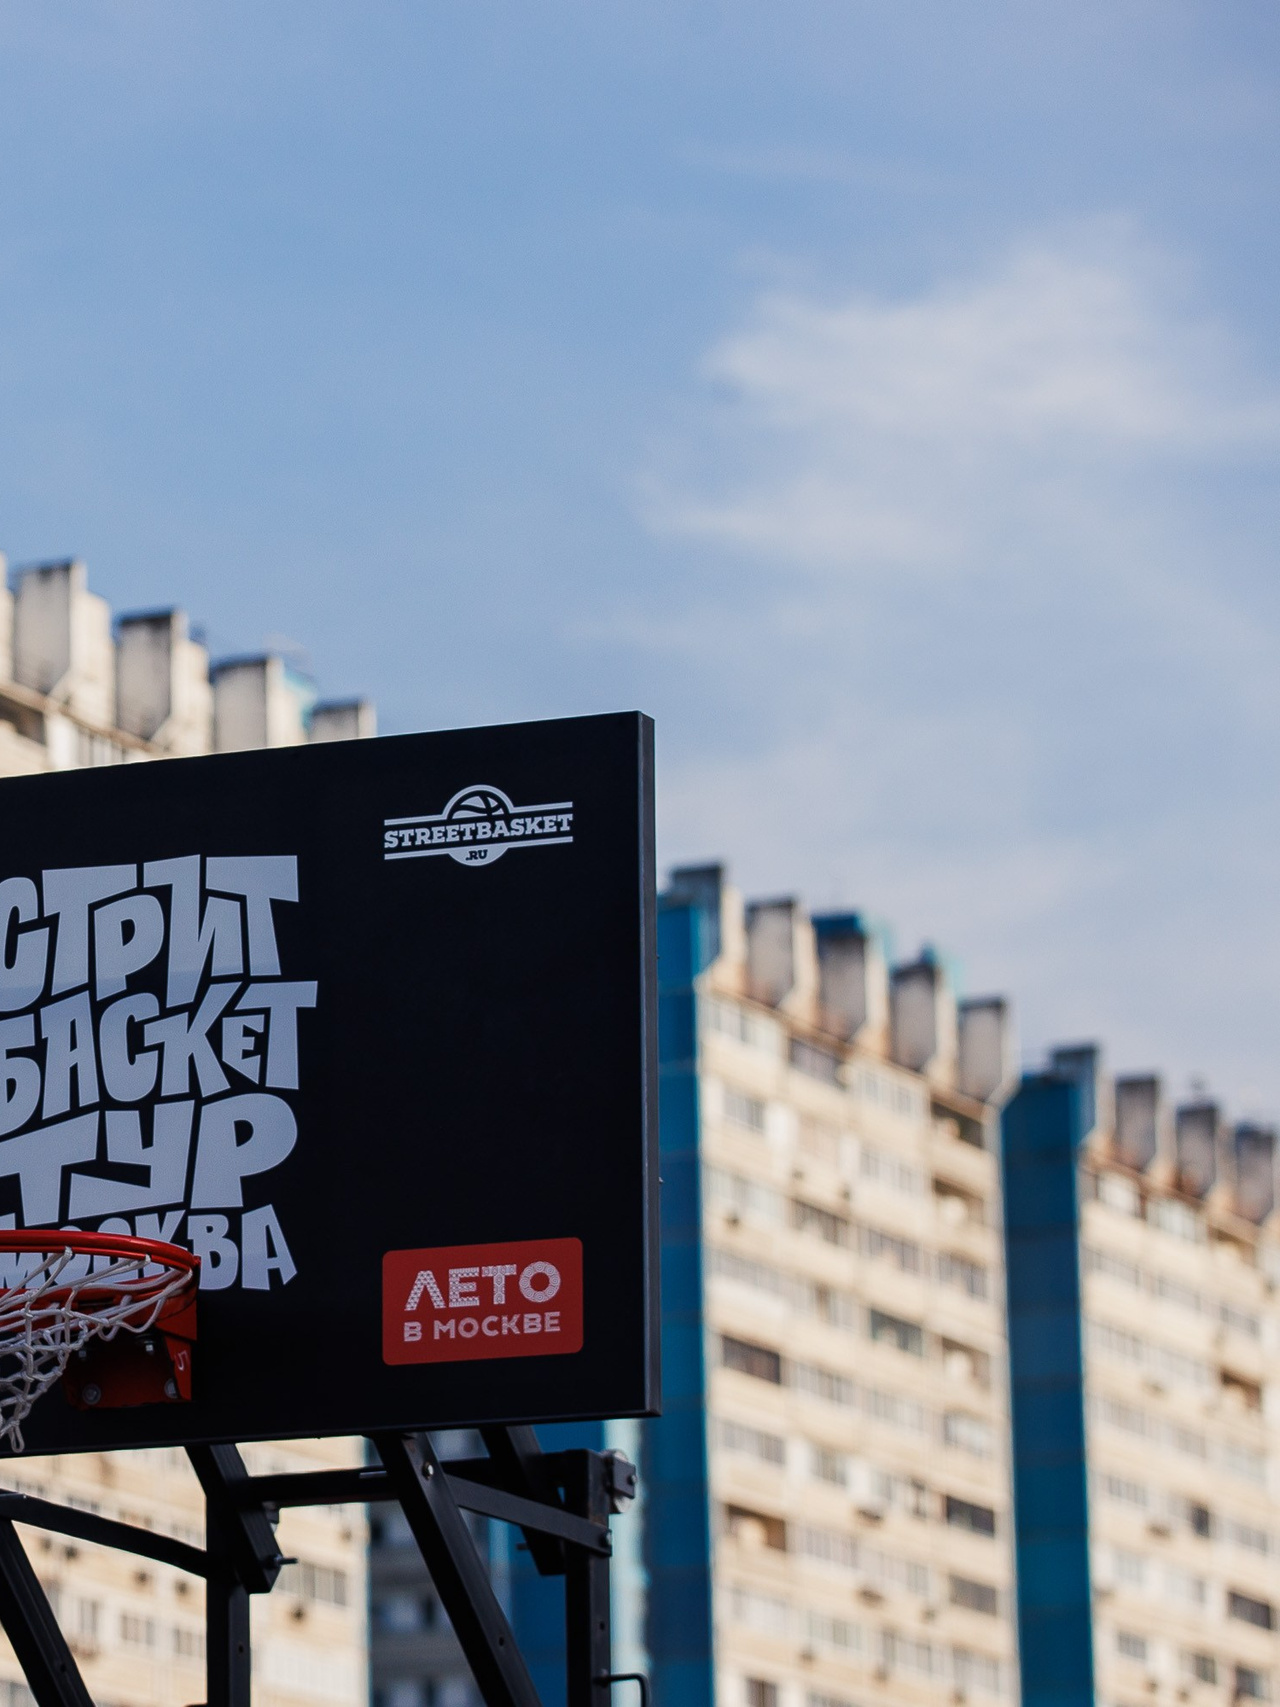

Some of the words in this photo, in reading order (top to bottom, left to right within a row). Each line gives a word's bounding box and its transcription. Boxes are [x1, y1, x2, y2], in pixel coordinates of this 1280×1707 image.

[384, 813, 573, 848] STREETBASKET
[404, 1261, 561, 1311] ЛЕТО
[404, 1321, 422, 1342] В
[433, 1311, 561, 1340] МОСКВЕ
